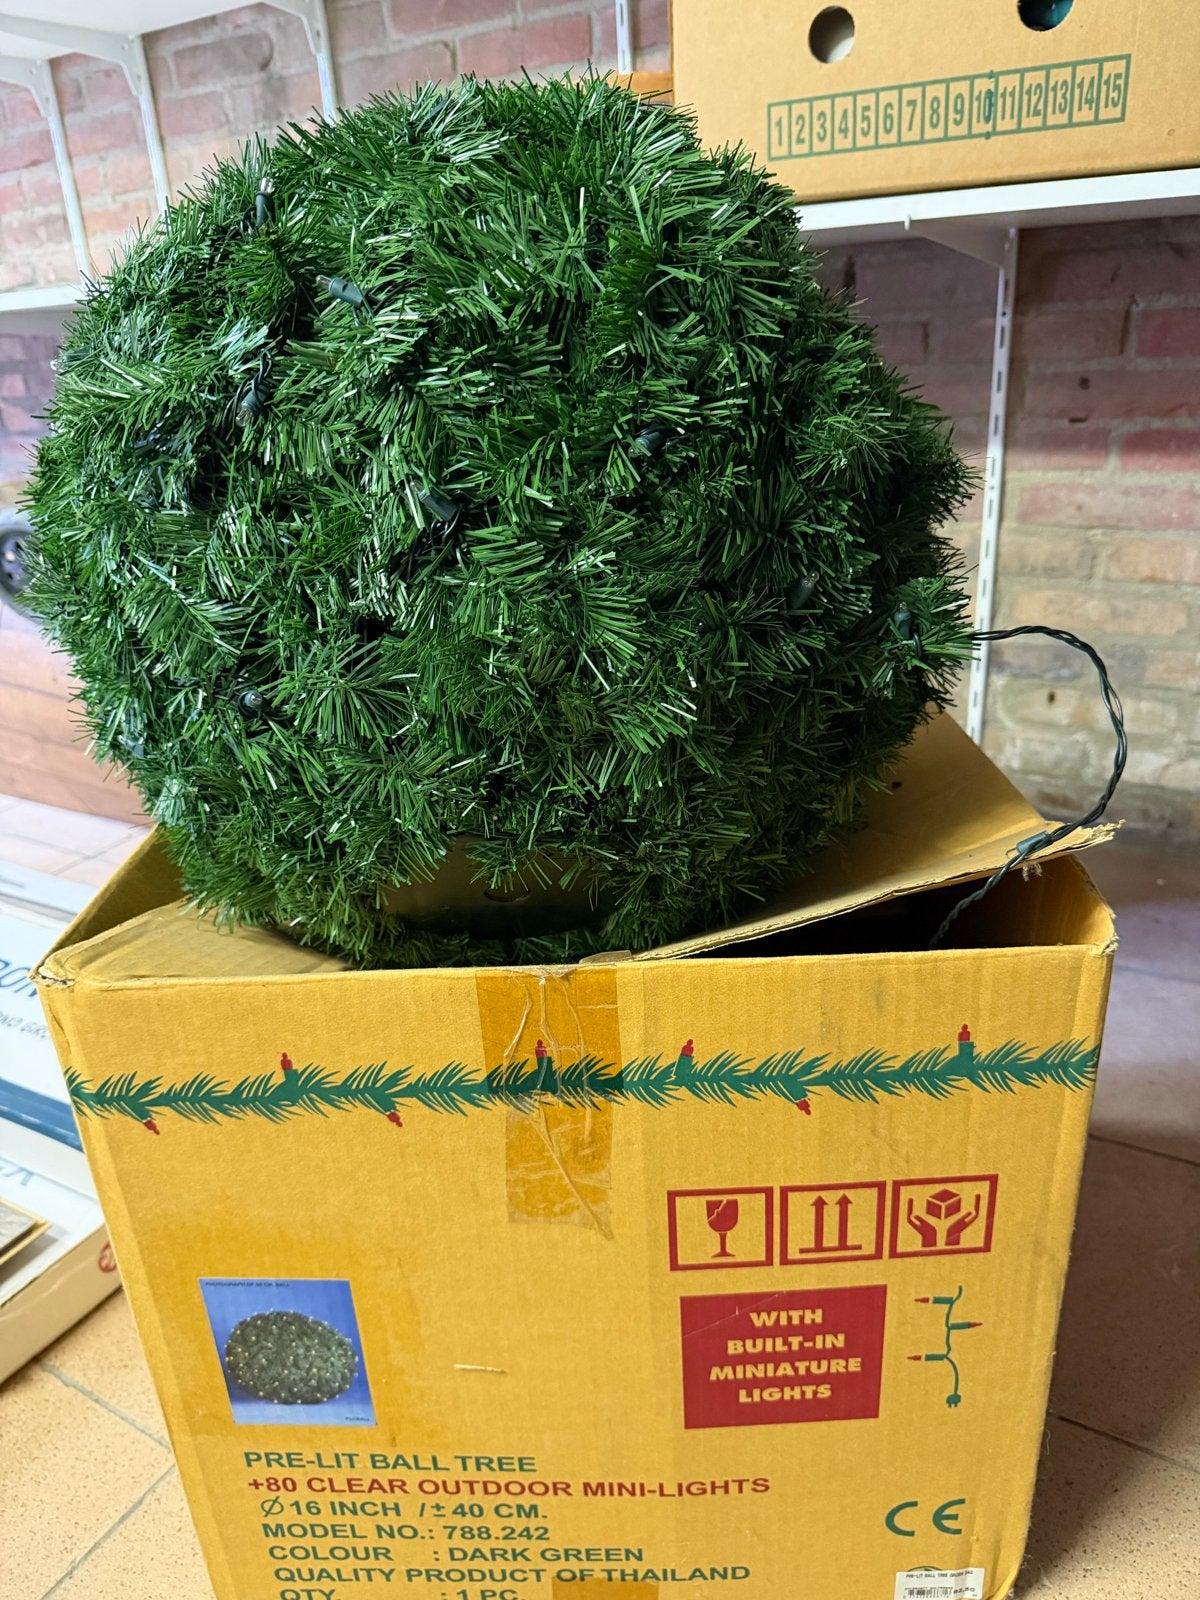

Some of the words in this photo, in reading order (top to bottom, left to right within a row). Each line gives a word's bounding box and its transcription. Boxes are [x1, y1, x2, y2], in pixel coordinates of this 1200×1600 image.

[775, 117, 782, 147] 1
[796, 114, 805, 145] 2
[816, 111, 827, 142] 3
[838, 108, 849, 139] 4
[860, 105, 871, 137] 5
[883, 102, 894, 134] 6
[906, 99, 917, 131] 7
[929, 96, 940, 129] 8
[953, 93, 965, 126] 9
[975, 89, 993, 124] 10
[1000, 85, 1016, 121] 11
[1025, 83, 1043, 118] 12
[1051, 79, 1069, 115] 13
[1077, 76, 1096, 112] 14
[1103, 72, 1123, 109] 15
[750, 1308, 823, 1328] WITH
[727, 1333, 845, 1355] BUILT-IN
[709, 1357, 862, 1381] MINIATURE
[738, 1384, 832, 1403] LIGHTS
[244, 1452, 359, 1469] PRE-LIT
[369, 1453, 450, 1471] BALL
[454, 1455, 538, 1472] TREE
[248, 1476, 298, 1493] +80
[306, 1477, 411, 1494] CLEAR
[418, 1479, 573, 1497] OUTDOOR
[582, 1477, 771, 1498] MINI-LIGHTS
[329, 1500, 401, 1517] INCH
[493, 1503, 549, 1519] CM.
[884, 1497, 967, 1537] CE
[262, 1523, 368, 1539] MODEL
[442, 1525, 550, 1541] 788.242
[268, 1545, 394, 1561] COLOUR
[448, 1547, 532, 1562] DARK
[540, 1547, 644, 1562] GREEN
[274, 1567, 396, 1583] QUALITY
[405, 1568, 547, 1583] PRODUCT
[555, 1568, 595, 1583] OF
[600, 1566, 751, 1583] THAILAND
[456, 1589, 472, 1600] 1
